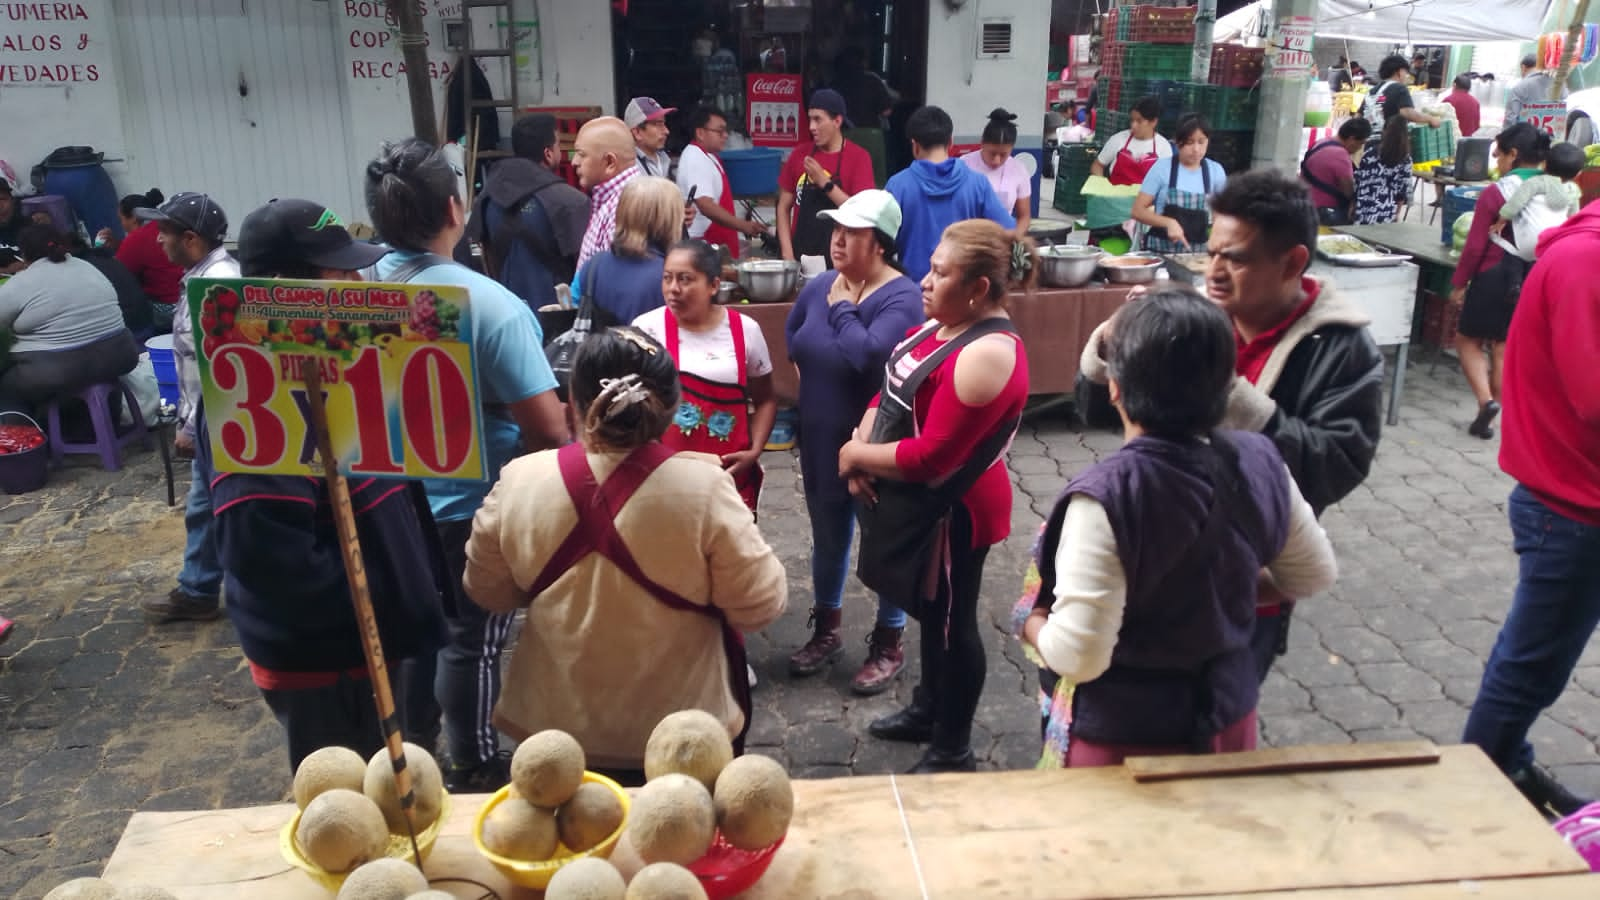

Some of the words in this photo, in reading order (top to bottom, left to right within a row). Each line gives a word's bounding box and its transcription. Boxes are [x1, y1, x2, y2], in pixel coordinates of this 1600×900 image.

[244, 286, 272, 304] DEL
[273, 287, 326, 305] CAMPO
[329, 289, 341, 305] A
[343, 290, 365, 306] SU
[368, 289, 409, 308] MESA
[279, 353, 338, 384] PIEAS
[213, 346, 285, 467] 3
[344, 346, 472, 474] 10
